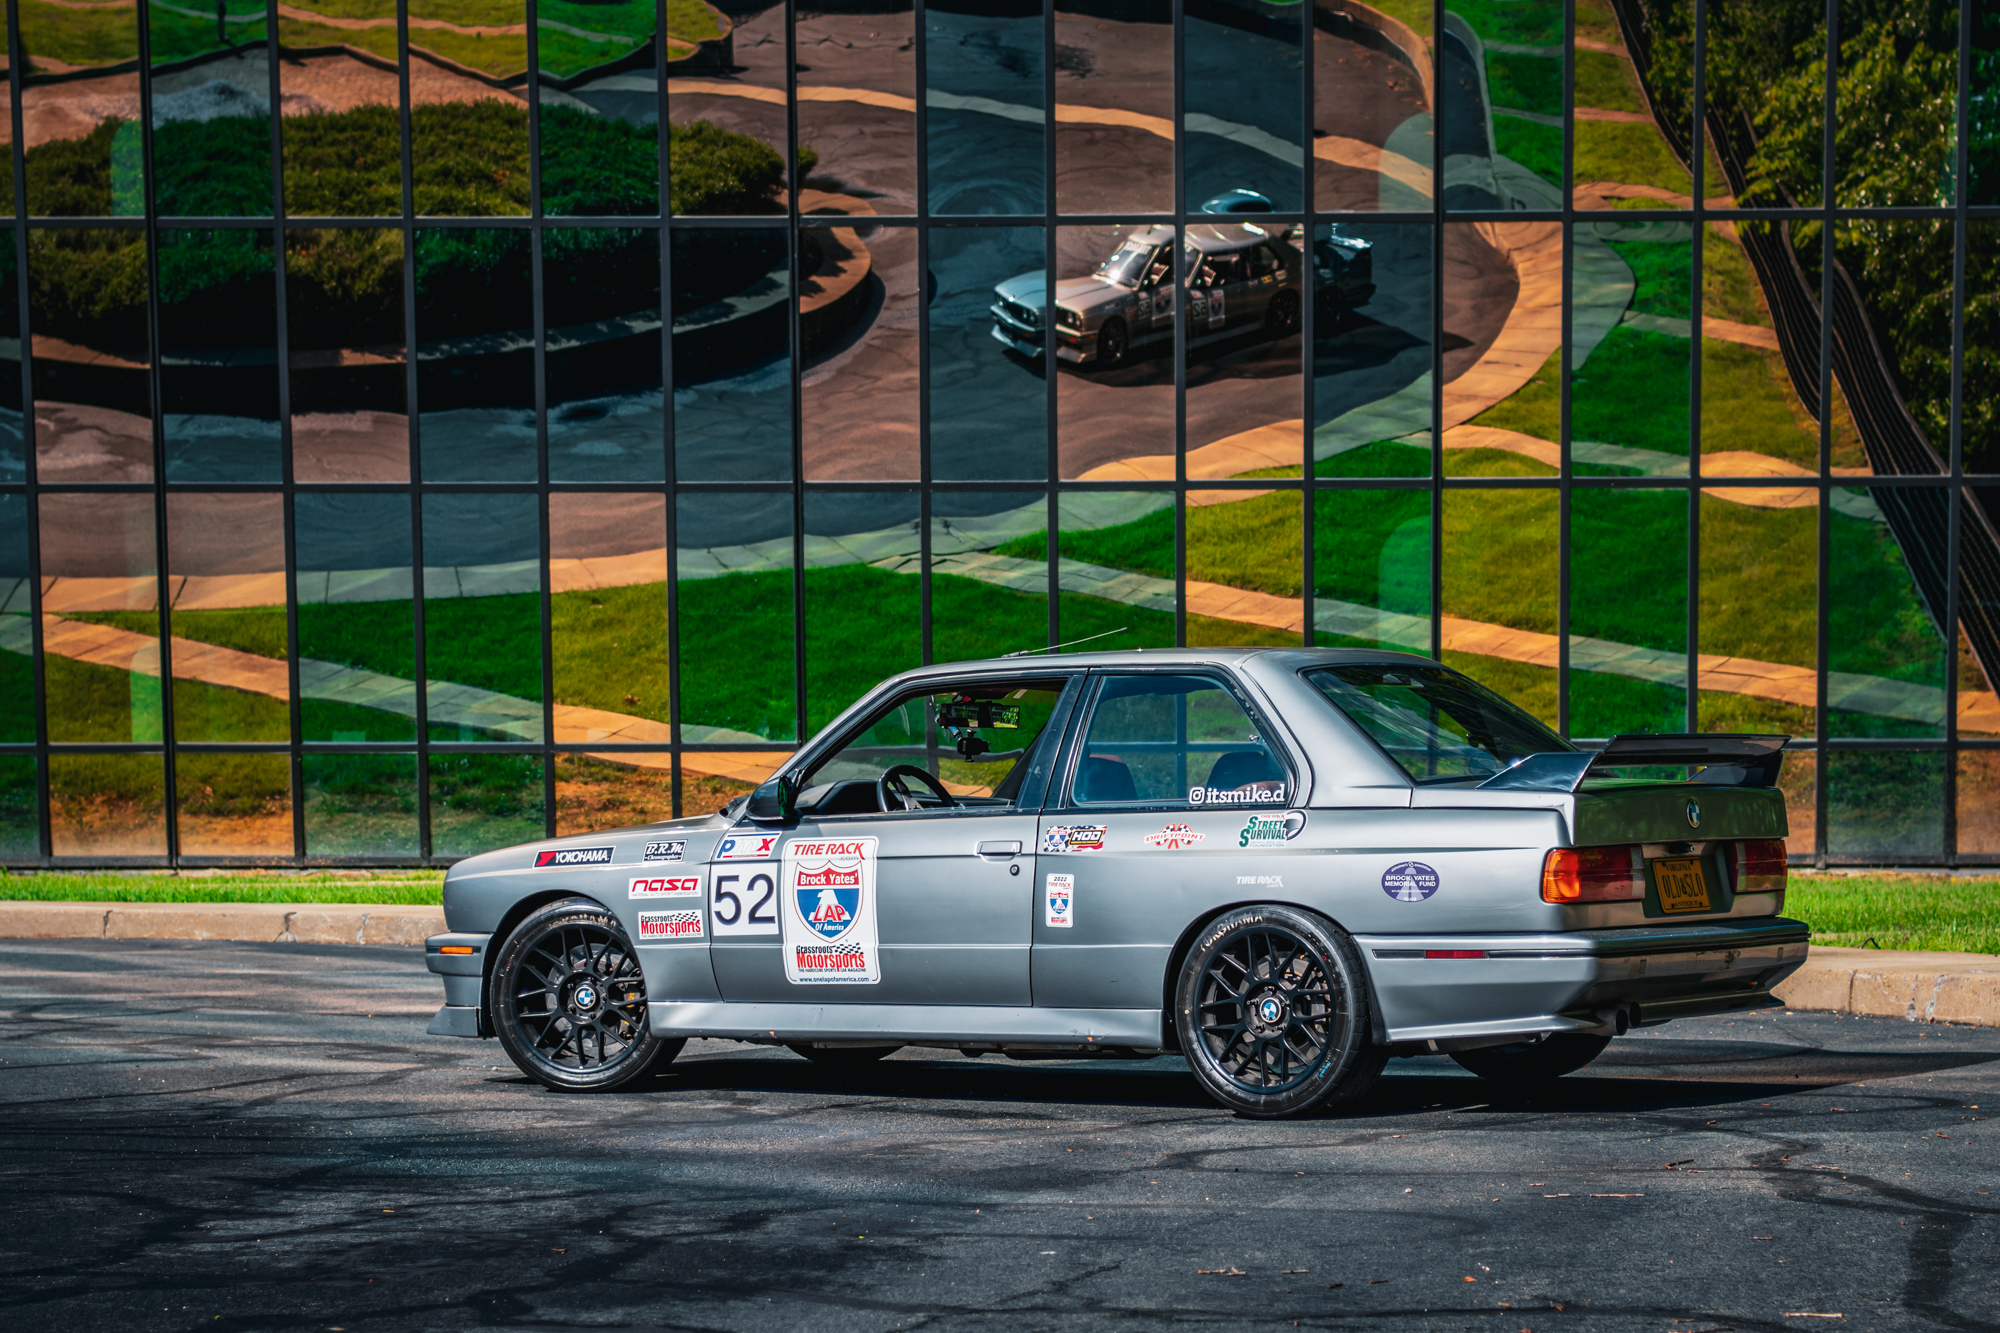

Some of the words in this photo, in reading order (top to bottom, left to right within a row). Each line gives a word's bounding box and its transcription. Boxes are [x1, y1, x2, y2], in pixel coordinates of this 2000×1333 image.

[1248, 816, 1284, 830] STREET
[1072, 831, 1102, 840] HOD
[1146, 833, 1203, 842] DRIFTPOINT
[1239, 828, 1285, 847] SURVIVAL
[556, 850, 608, 864] YOKOHAMA
[794, 844, 825, 856] TIRE
[825, 843, 865, 860] RACK
[1666, 863, 1692, 871] VIRGINIA
[800, 874, 826, 885] Brock
[829, 873, 857, 884] Yates'
[1236, 876, 1257, 884] TIRE
[1257, 876, 1283, 887] RACK
[714, 874, 776, 926] 52
[813, 905, 846, 922] LAP
[641, 921, 701, 936] Motorsports
[796, 945, 833, 954] Grassroots
[796, 952, 865, 972] Motorsports
